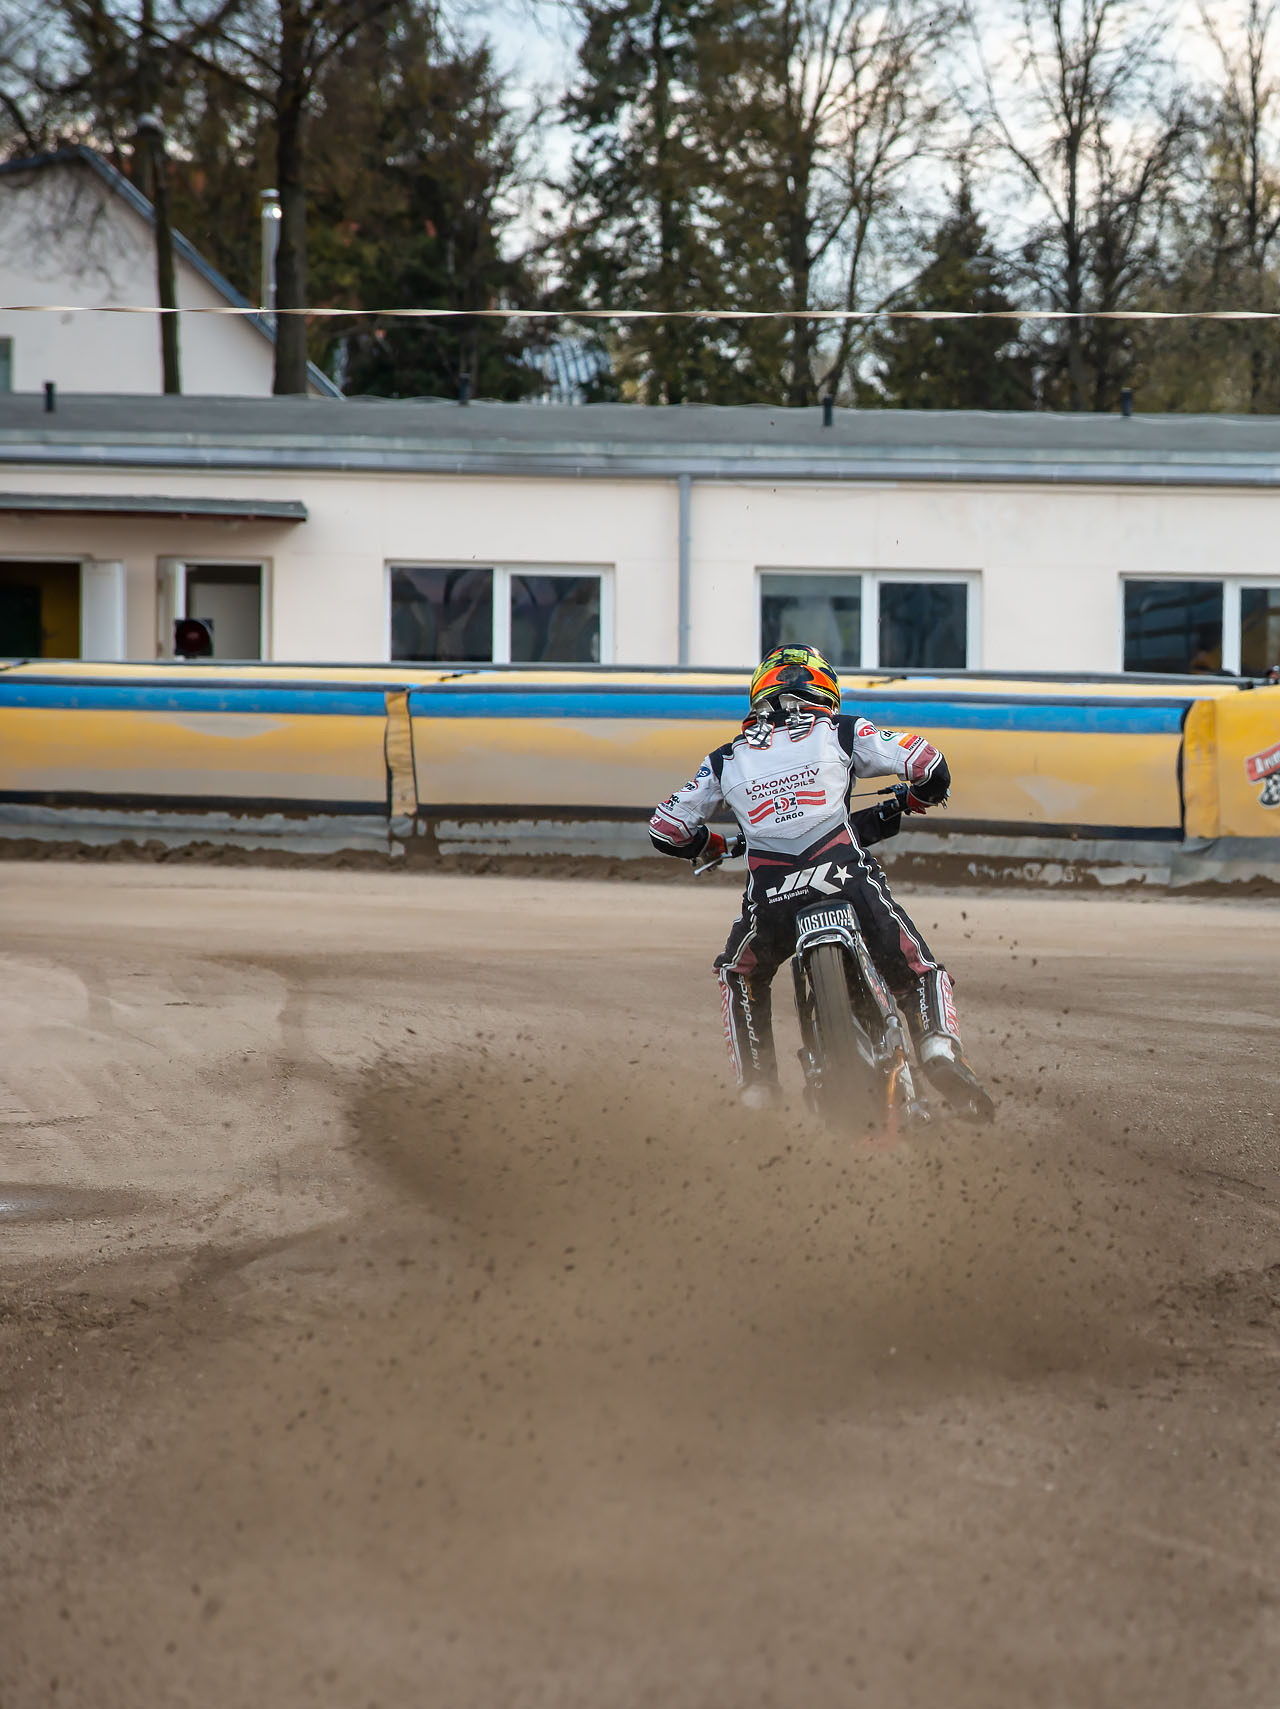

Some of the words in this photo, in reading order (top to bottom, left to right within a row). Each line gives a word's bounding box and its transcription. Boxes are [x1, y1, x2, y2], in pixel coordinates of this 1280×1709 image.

[745, 767, 820, 796] LOKOMOTIV
[751, 778, 816, 801] DAUGAVPILS
[774, 811, 804, 824] CARGO
